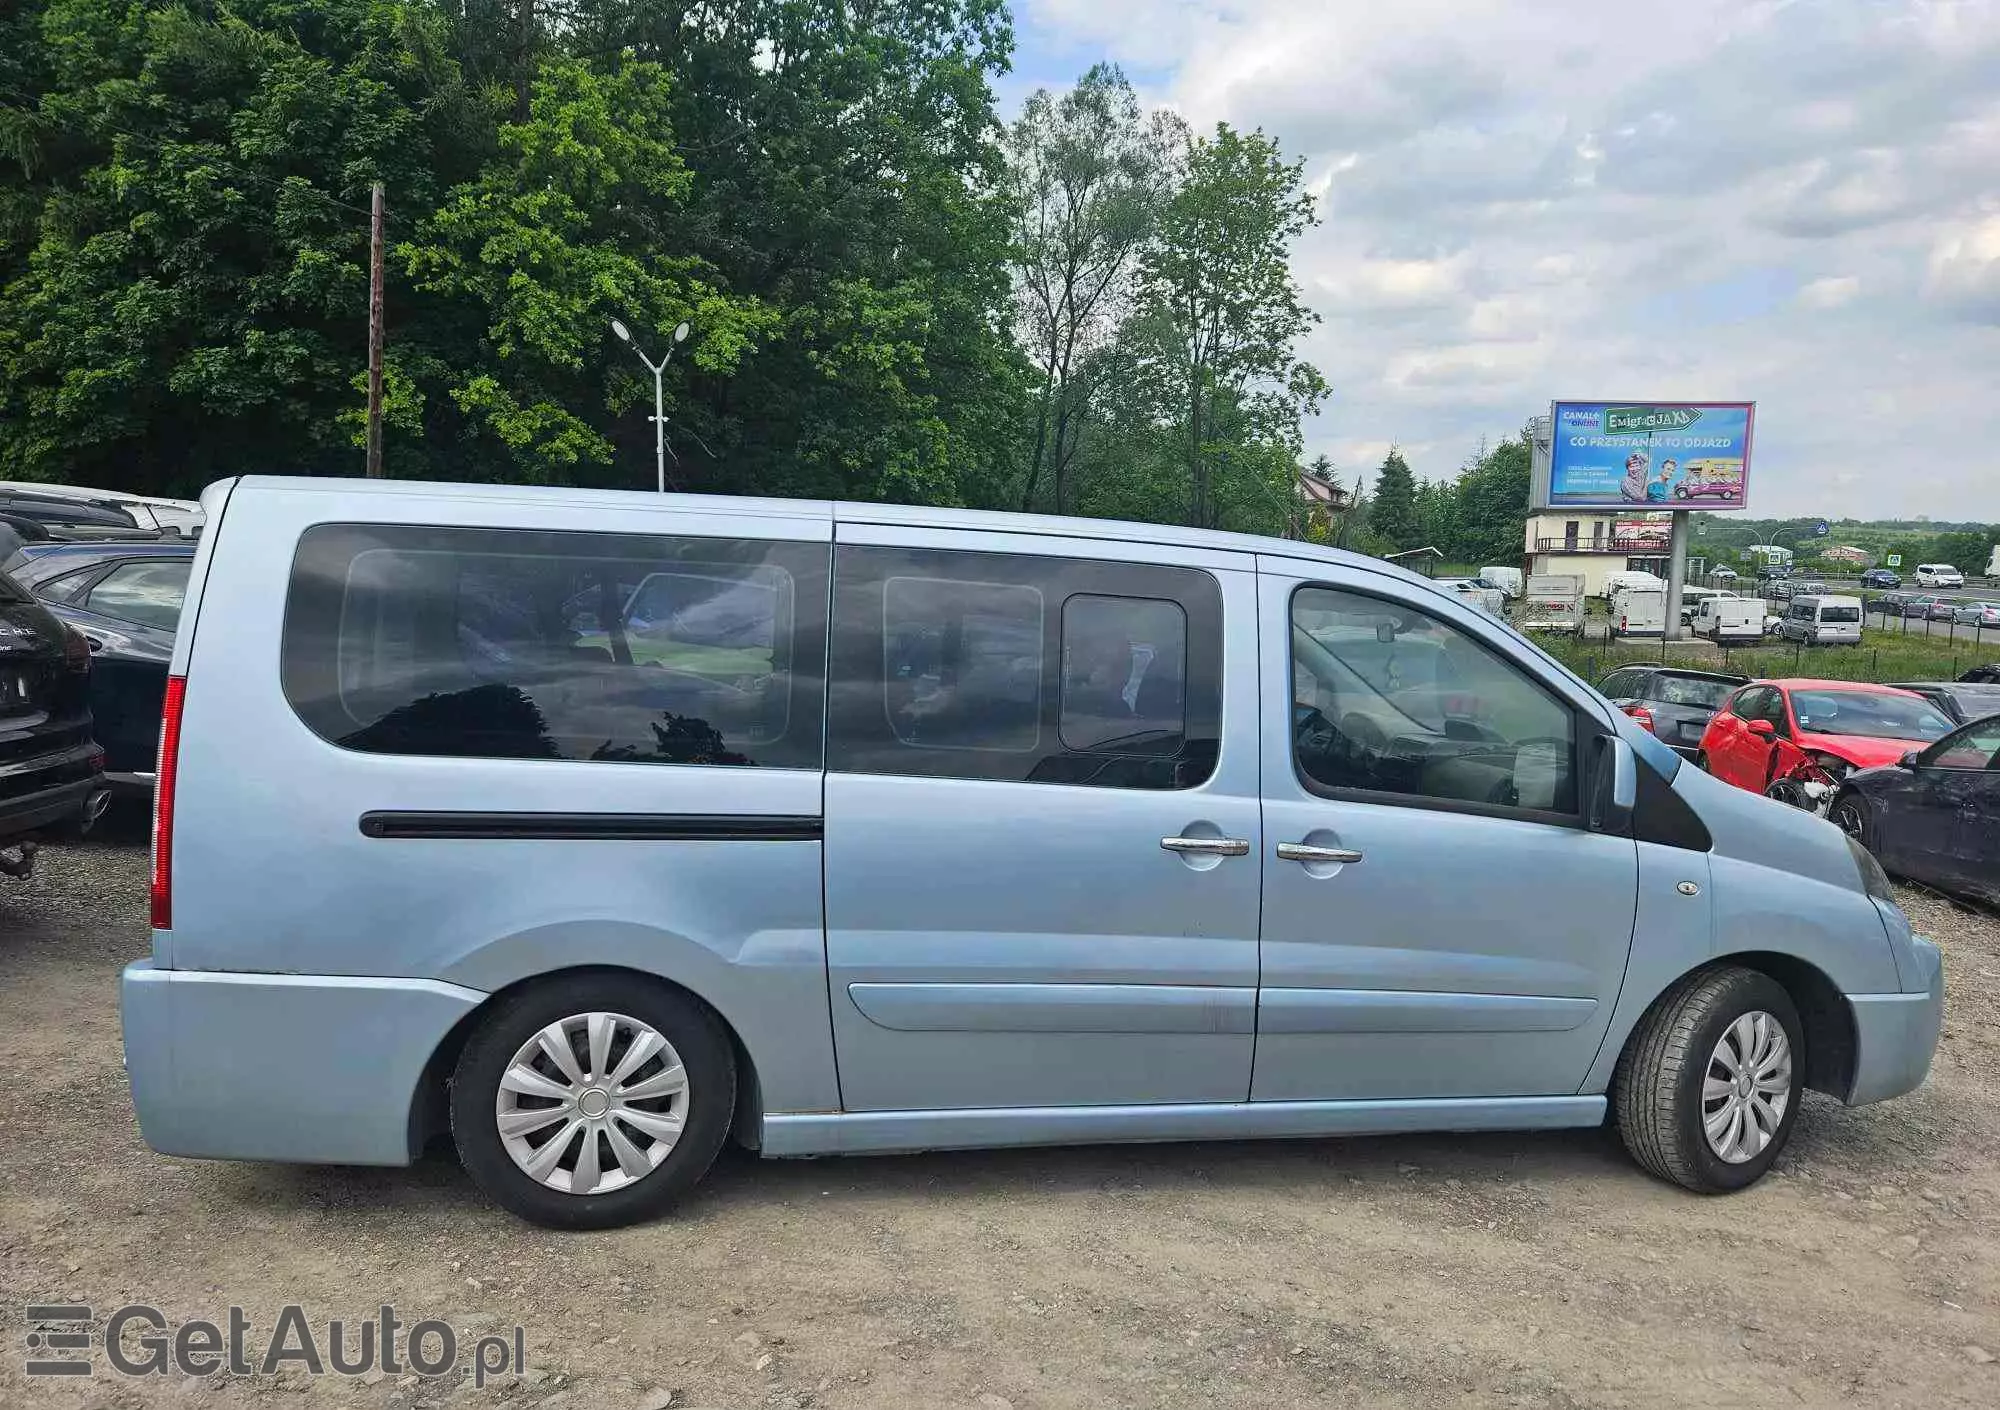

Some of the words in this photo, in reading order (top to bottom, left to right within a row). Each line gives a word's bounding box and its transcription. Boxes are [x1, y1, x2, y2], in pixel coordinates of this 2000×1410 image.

[1563, 411, 1600, 420] CANAL+
[1569, 437, 1586, 447] CO
[1589, 437, 1662, 448] PRZYSTANEK
[1665, 437, 1680, 447] TO
[1684, 438, 1731, 448] ODJAZD
